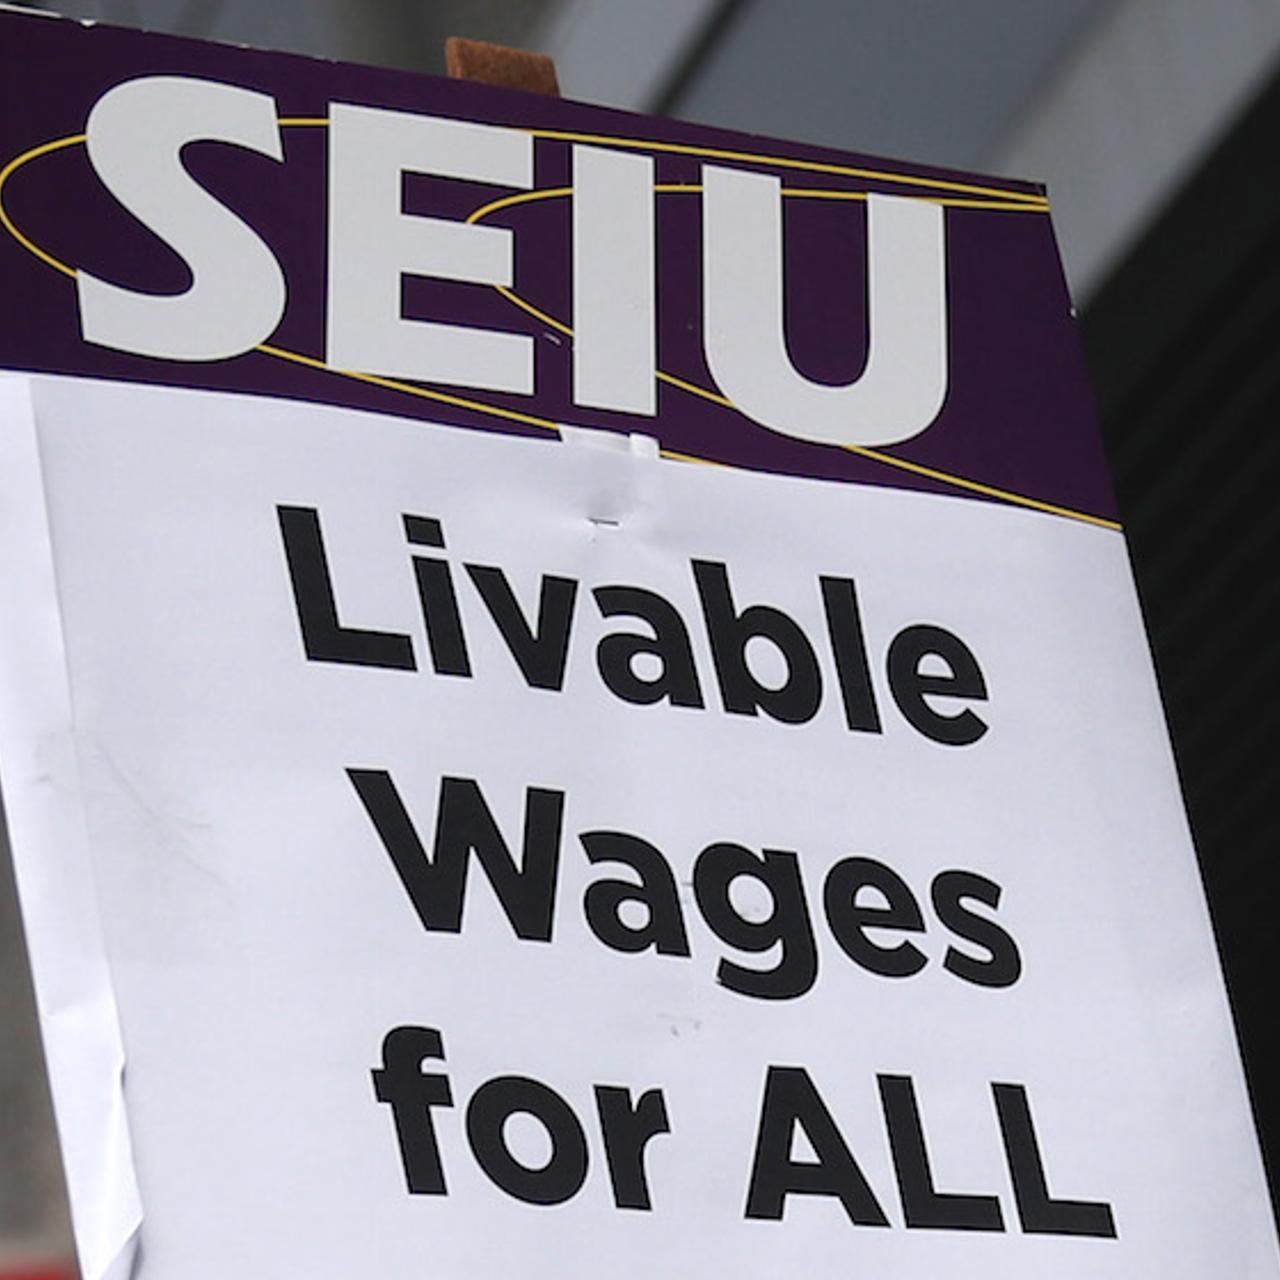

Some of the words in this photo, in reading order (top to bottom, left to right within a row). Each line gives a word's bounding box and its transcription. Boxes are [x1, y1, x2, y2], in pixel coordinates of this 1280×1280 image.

[76, 75, 948, 447] SEIU
[276, 504, 989, 746] Livable
[345, 768, 1021, 1000] Wages
[370, 1026, 671, 1211] for
[743, 1065, 1117, 1238] ALL
